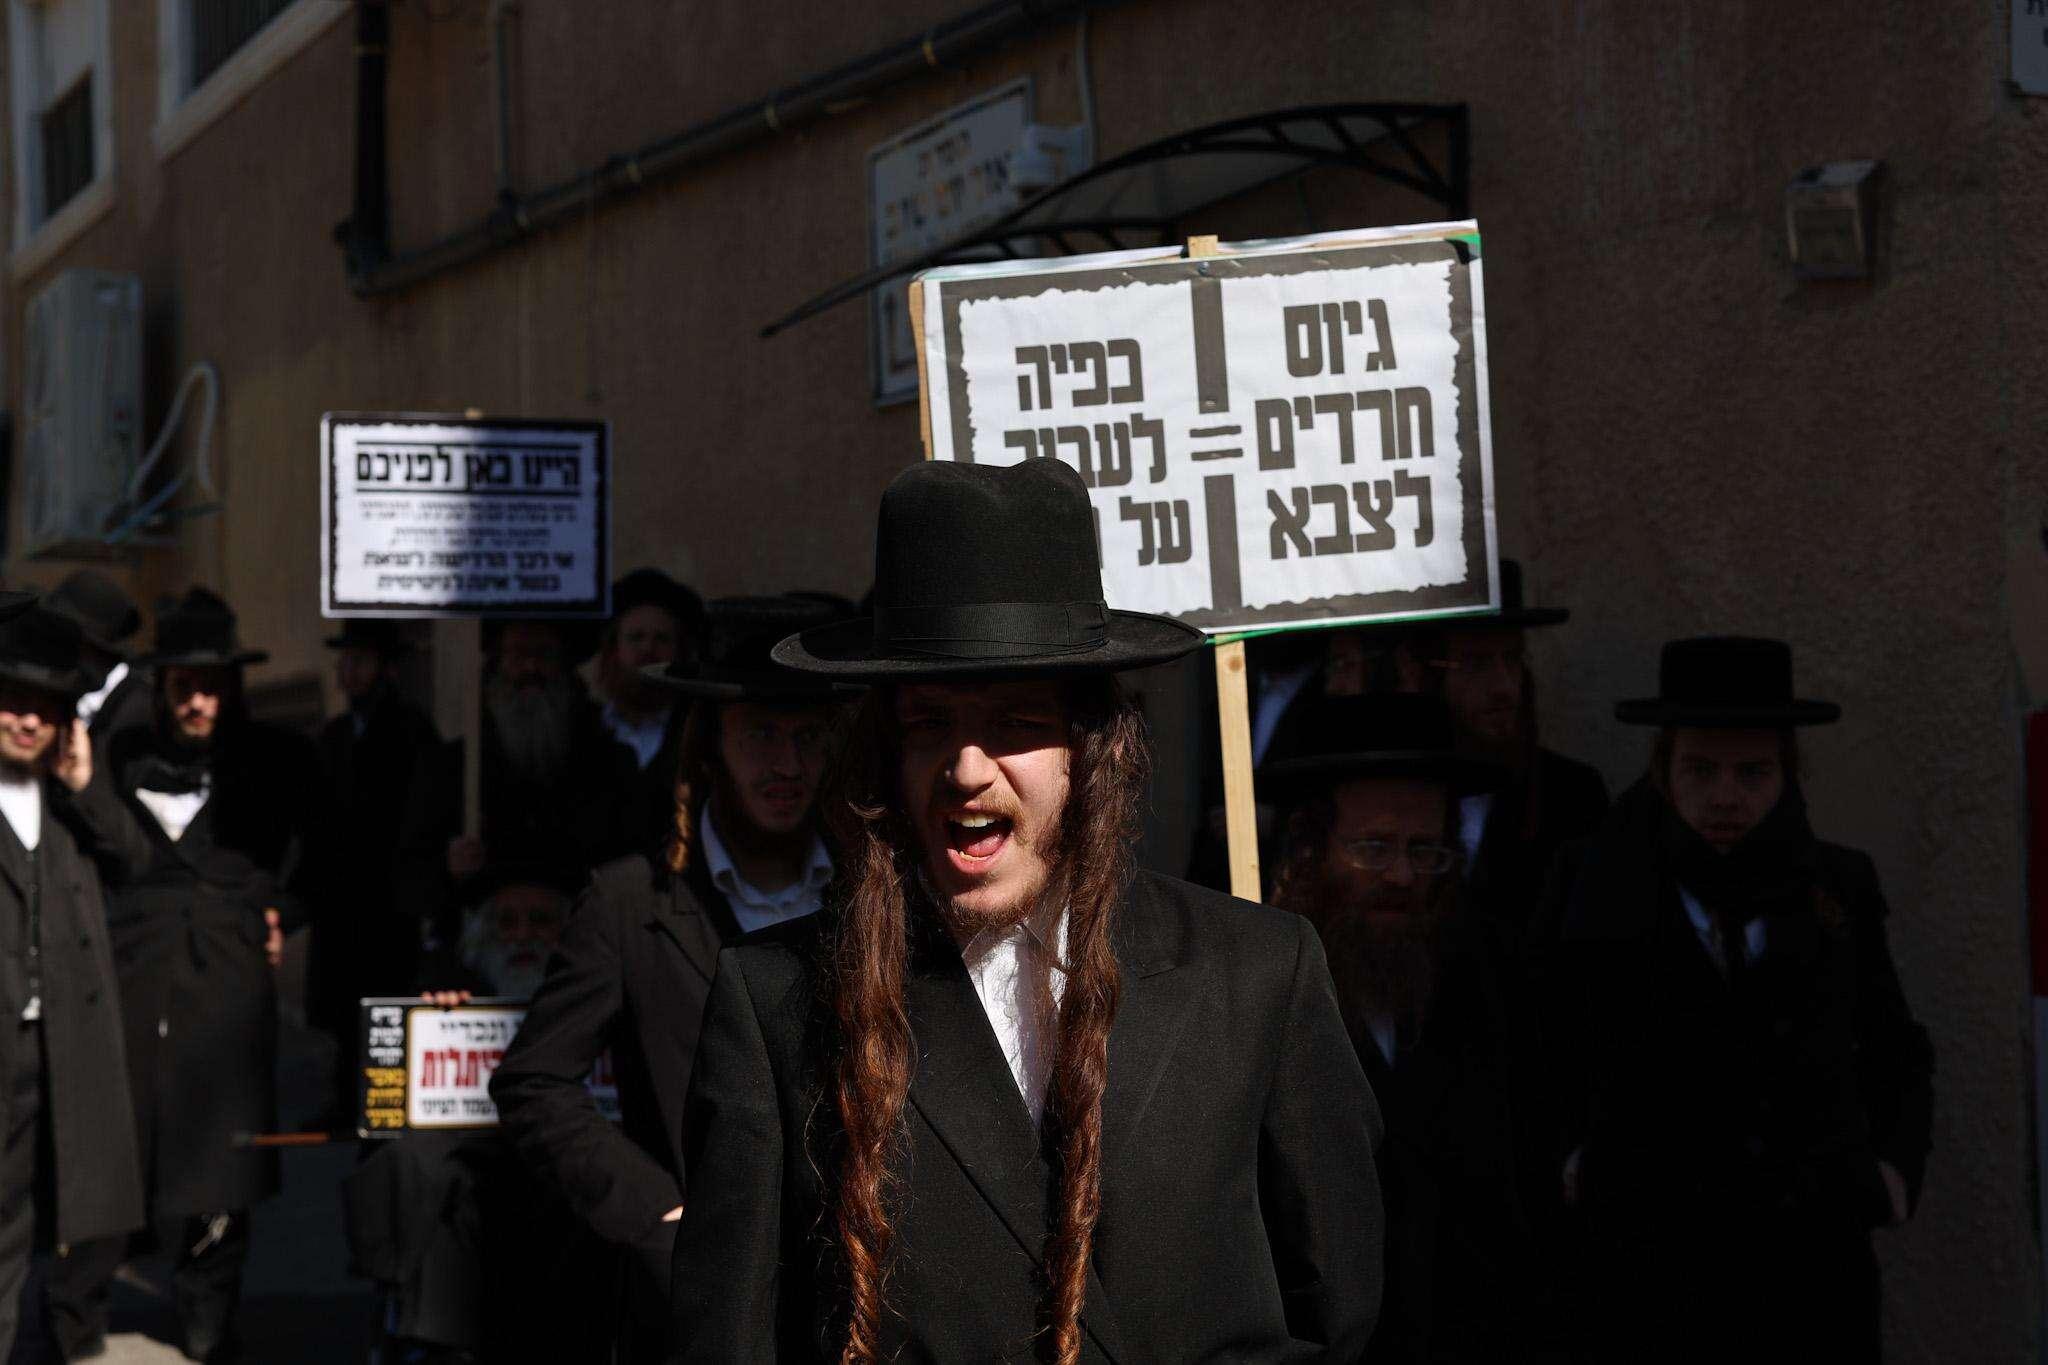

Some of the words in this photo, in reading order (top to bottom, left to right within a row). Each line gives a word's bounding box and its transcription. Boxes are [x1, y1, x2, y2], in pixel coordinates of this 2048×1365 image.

[1282, 298, 1398, 377] גיוס
[1014, 337, 1145, 412] כפיה
[356, 444, 452, 483] לפניכם
[1254, 386, 1436, 471] חרדים
[463, 452, 512, 491] כאן
[522, 453, 580, 486] היינו
[1118, 496, 1193, 567] על
[1267, 469, 1436, 560] לצבא
